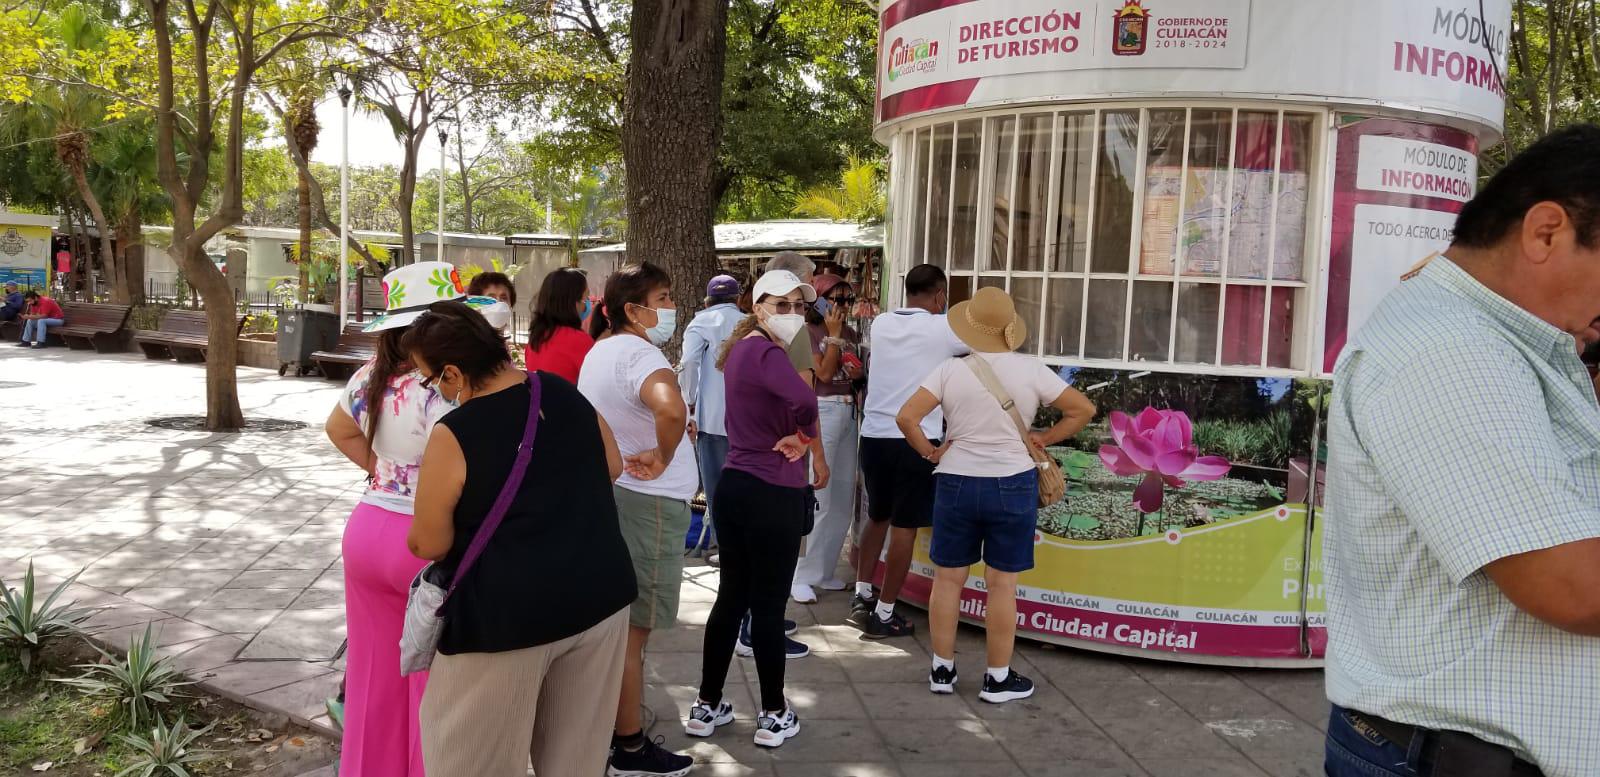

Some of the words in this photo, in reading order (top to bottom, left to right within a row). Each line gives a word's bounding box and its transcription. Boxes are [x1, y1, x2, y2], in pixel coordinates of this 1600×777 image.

[960, 9, 1081, 43] DIRECCIÓN
[1157, 18, 1213, 27] GOBIERNO
[1214, 18, 1229, 27] DE
[1432, 7, 1504, 57] MÓDULO
[1156, 26, 1228, 39] CULIACÁN
[958, 46, 979, 64] DE
[982, 36, 1079, 60] TURISMO
[1155, 40, 1227, 48] 2018-2024
[1403, 146, 1456, 171] MÓDULO
[1457, 156, 1468, 174] DE
[1381, 168, 1472, 199] INFORMACIÓN
[1368, 221, 1403, 237] TODO
[1405, 225, 1441, 240] ACERCA
[1041, 593, 1100, 609] CULIACÁN
[1116, 603, 1180, 618] CULIACÁN
[1195, 611, 1258, 625] CULIACÁN
[1031, 611, 1109, 639] Ciudad
[1113, 624, 1198, 649] Capital
